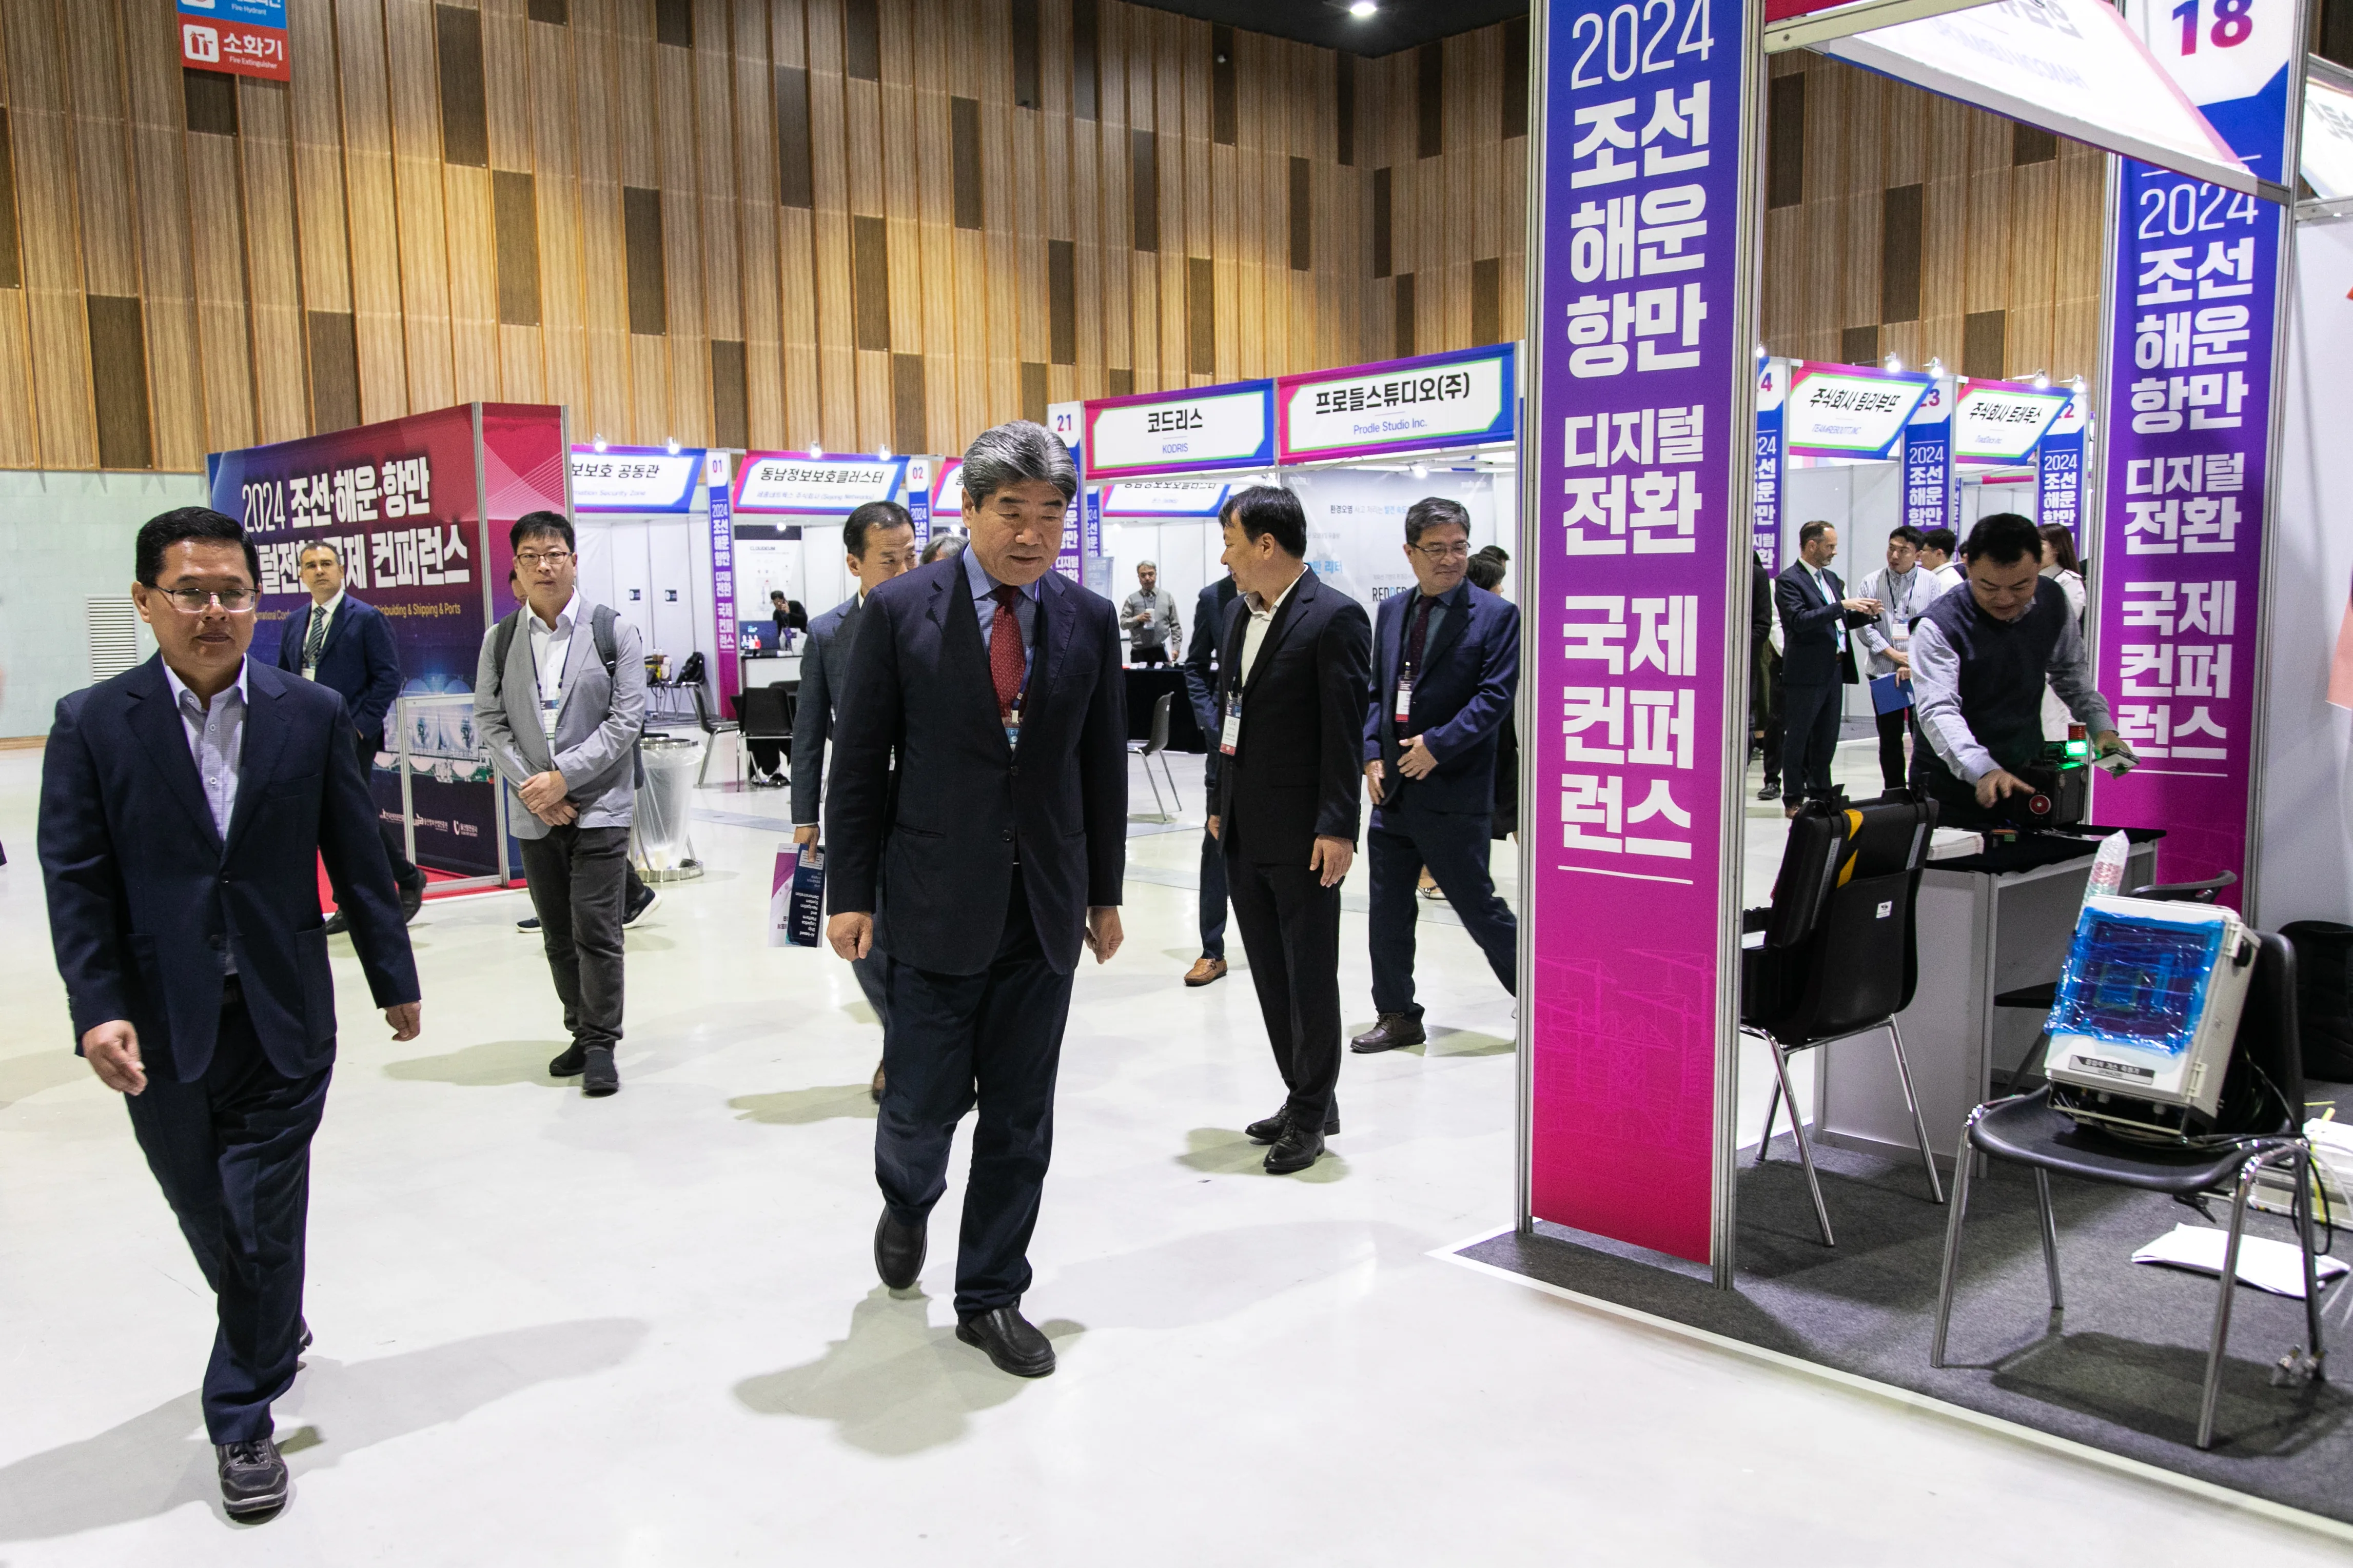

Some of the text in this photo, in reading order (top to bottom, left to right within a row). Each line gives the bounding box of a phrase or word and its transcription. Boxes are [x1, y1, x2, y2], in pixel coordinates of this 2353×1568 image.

[2172, 0, 2254, 56] 18
[224, 33, 283, 61] 소화기
[1571, 0, 1714, 90] 2024
[1571, 80, 1710, 189] 조선
[2139, 182, 2258, 240] 2024
[1571, 183, 1708, 283] 해운
[2136, 237, 2254, 306] 조선
[1567, 282, 1707, 379] 항만
[2135, 305, 2250, 370] 해운
[1757, 372, 1773, 392] 4
[1316, 372, 1470, 414] 프로들스튜디오(주)
[1810, 388, 1858, 410] 주식회사
[1920, 389, 1940, 407] 3
[2131, 371, 2249, 434] 항만
[1148, 408, 1203, 433] 코드리스
[1970, 403, 2011, 421] 주식회사
[2057, 403, 2075, 419] 2
[1057, 414, 1071, 432] 21
[1354, 418, 1427, 435] Prodle Studio Inc.
[1563, 405, 1704, 468] 디지털
[1757, 436, 1777, 455] 24
[1162, 443, 1188, 454] KODRIS
[1909, 446, 1944, 464] 2024
[572, 463, 660, 478] 보보호 공동관
[713, 460, 722, 473] 01
[1755, 458, 1776, 480] 선
[2044, 454, 2077, 471] 2024
[761, 467, 884, 484] 동남정보보호클러스터
[912, 467, 924, 479] 02
[1909, 465, 1944, 486] 조선
[2044, 472, 2076, 490] 조선
[2126, 452, 2245, 494] 디지털
[242, 457, 430, 533] 2024 조선·해운·항만
[1909, 486, 1943, 506] 해운
[2043, 491, 2076, 509] 해운
[712, 503, 728, 518] 2024
[911, 507, 927, 520] 2024
[1064, 510, 1077, 528] 운
[1397, 506, 1407, 514] 속도
[1563, 471, 1703, 556] 전환
[1908, 507, 1943, 527] 항만
[713, 519, 729, 534] 조선
[1087, 522, 1097, 535] 선
[2124, 497, 2242, 555] 전환
[1753, 533, 1775, 548] 지털
[371, 524, 469, 589] 컨퍼런스
[1055, 555, 1079, 568] 디지털
[1757, 549, 1774, 569] 환
[1372, 587, 1406, 601] REDD
[407, 604, 412, 615] &
[413, 603, 438, 618] Shipping
[439, 603, 443, 614] &
[444, 603, 461, 614] Ports
[2122, 581, 2237, 636] 국제
[1563, 595, 1698, 676] 국제
[2120, 644, 2232, 699] 컨퍼
[1562, 686, 1695, 769] 컨퍼
[2116, 705, 2228, 760] 런스
[1560, 772, 1692, 860] 런스
